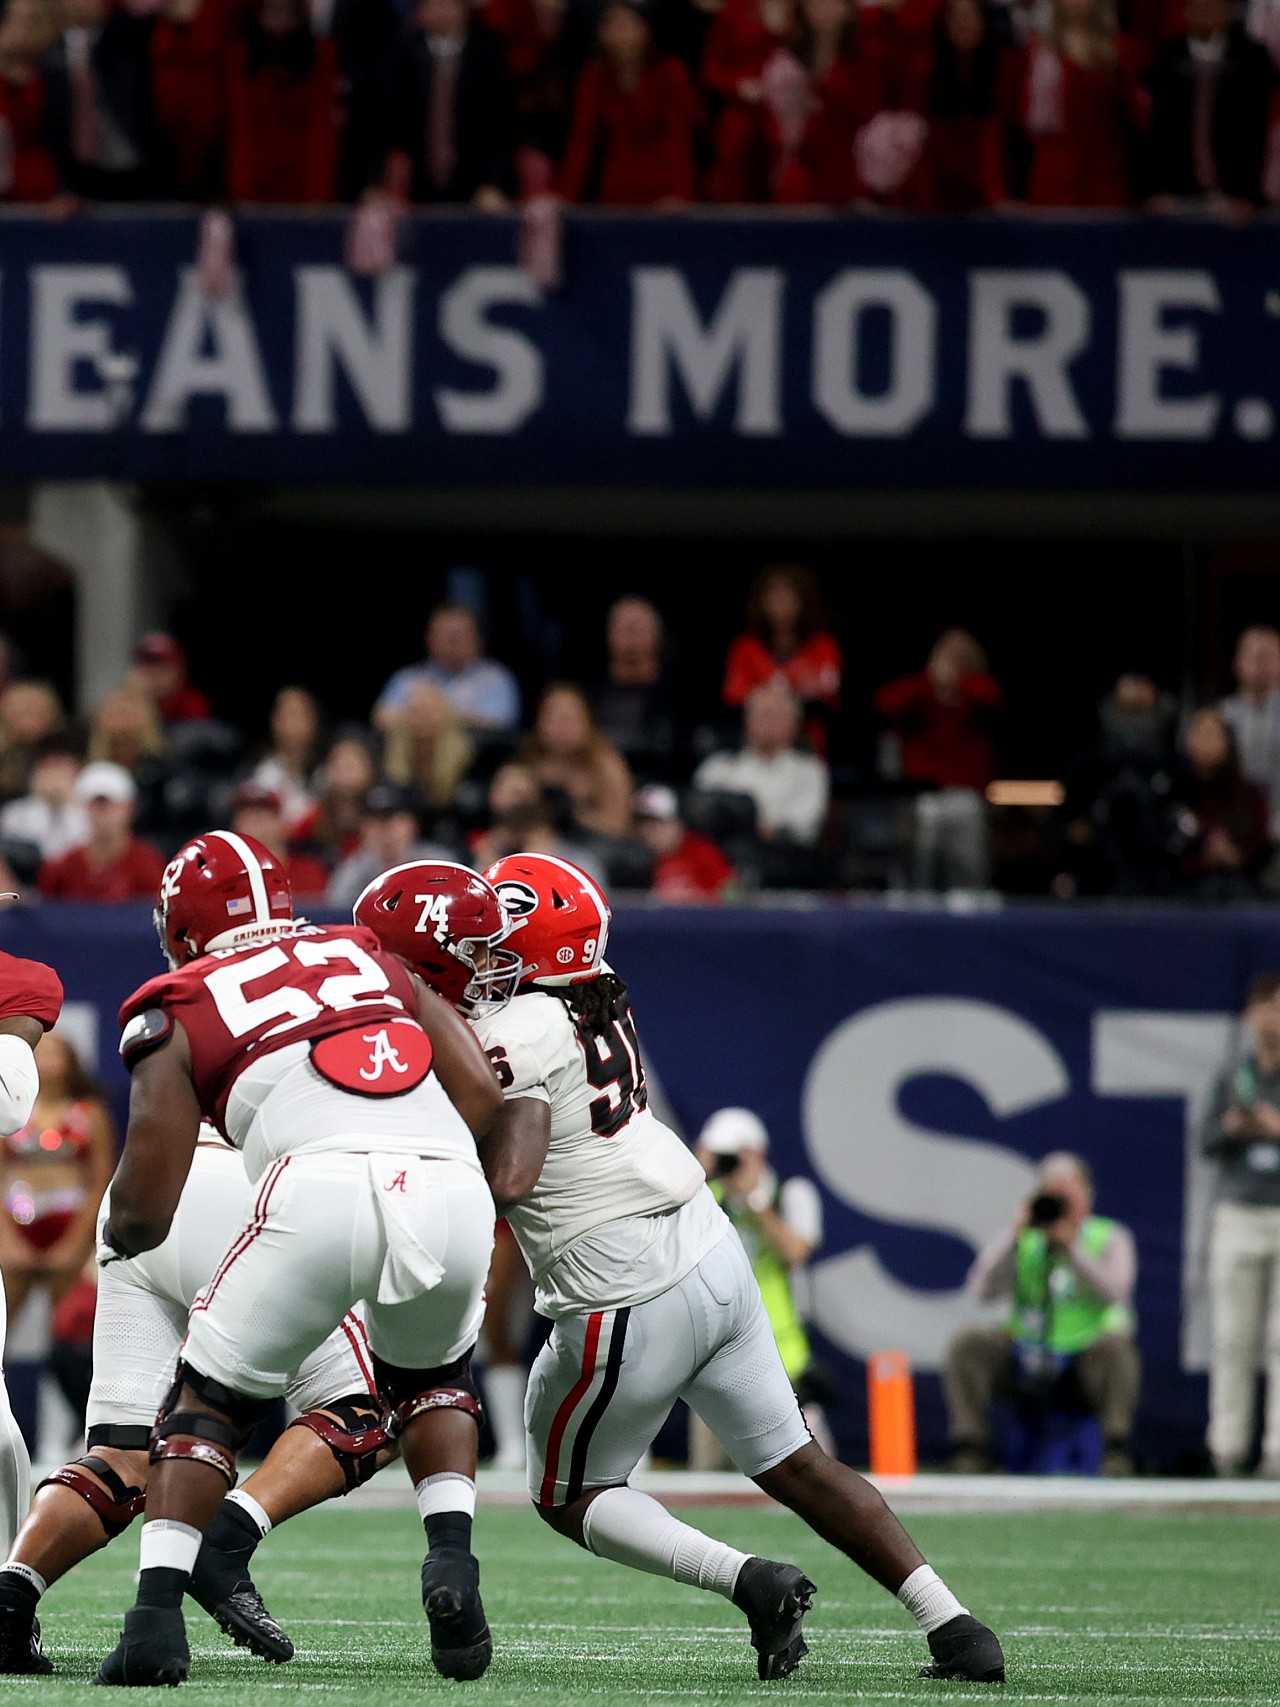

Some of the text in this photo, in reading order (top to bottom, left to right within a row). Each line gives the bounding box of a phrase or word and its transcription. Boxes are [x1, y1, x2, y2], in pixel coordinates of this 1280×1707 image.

[627, 264, 1275, 440] MORE.
[414, 894, 453, 933] 74
[203, 938, 404, 1050] 52
